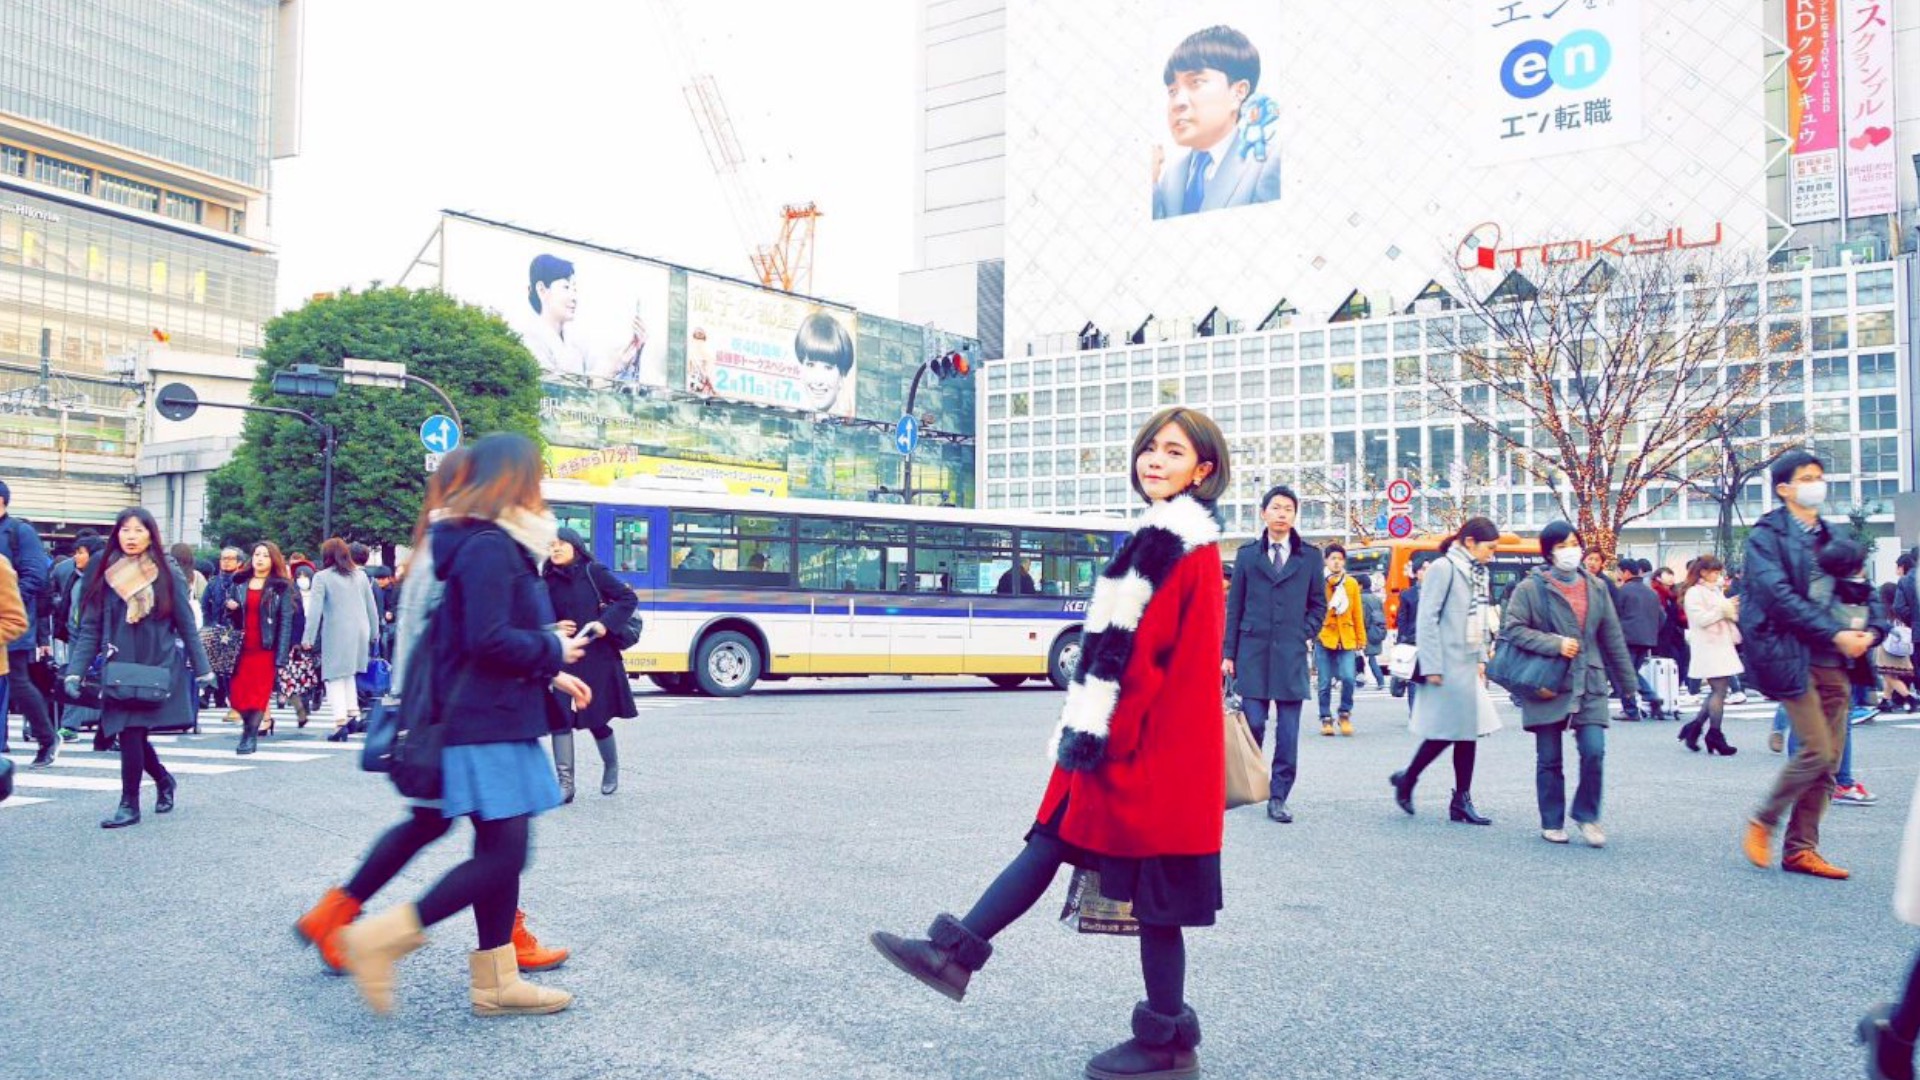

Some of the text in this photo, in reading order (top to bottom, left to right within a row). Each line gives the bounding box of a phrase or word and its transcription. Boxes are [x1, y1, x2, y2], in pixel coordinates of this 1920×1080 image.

[1510, 41, 1599, 88] en
[1500, 97, 1613, 139] エン転職
[1498, 221, 1722, 269] TOKYU
